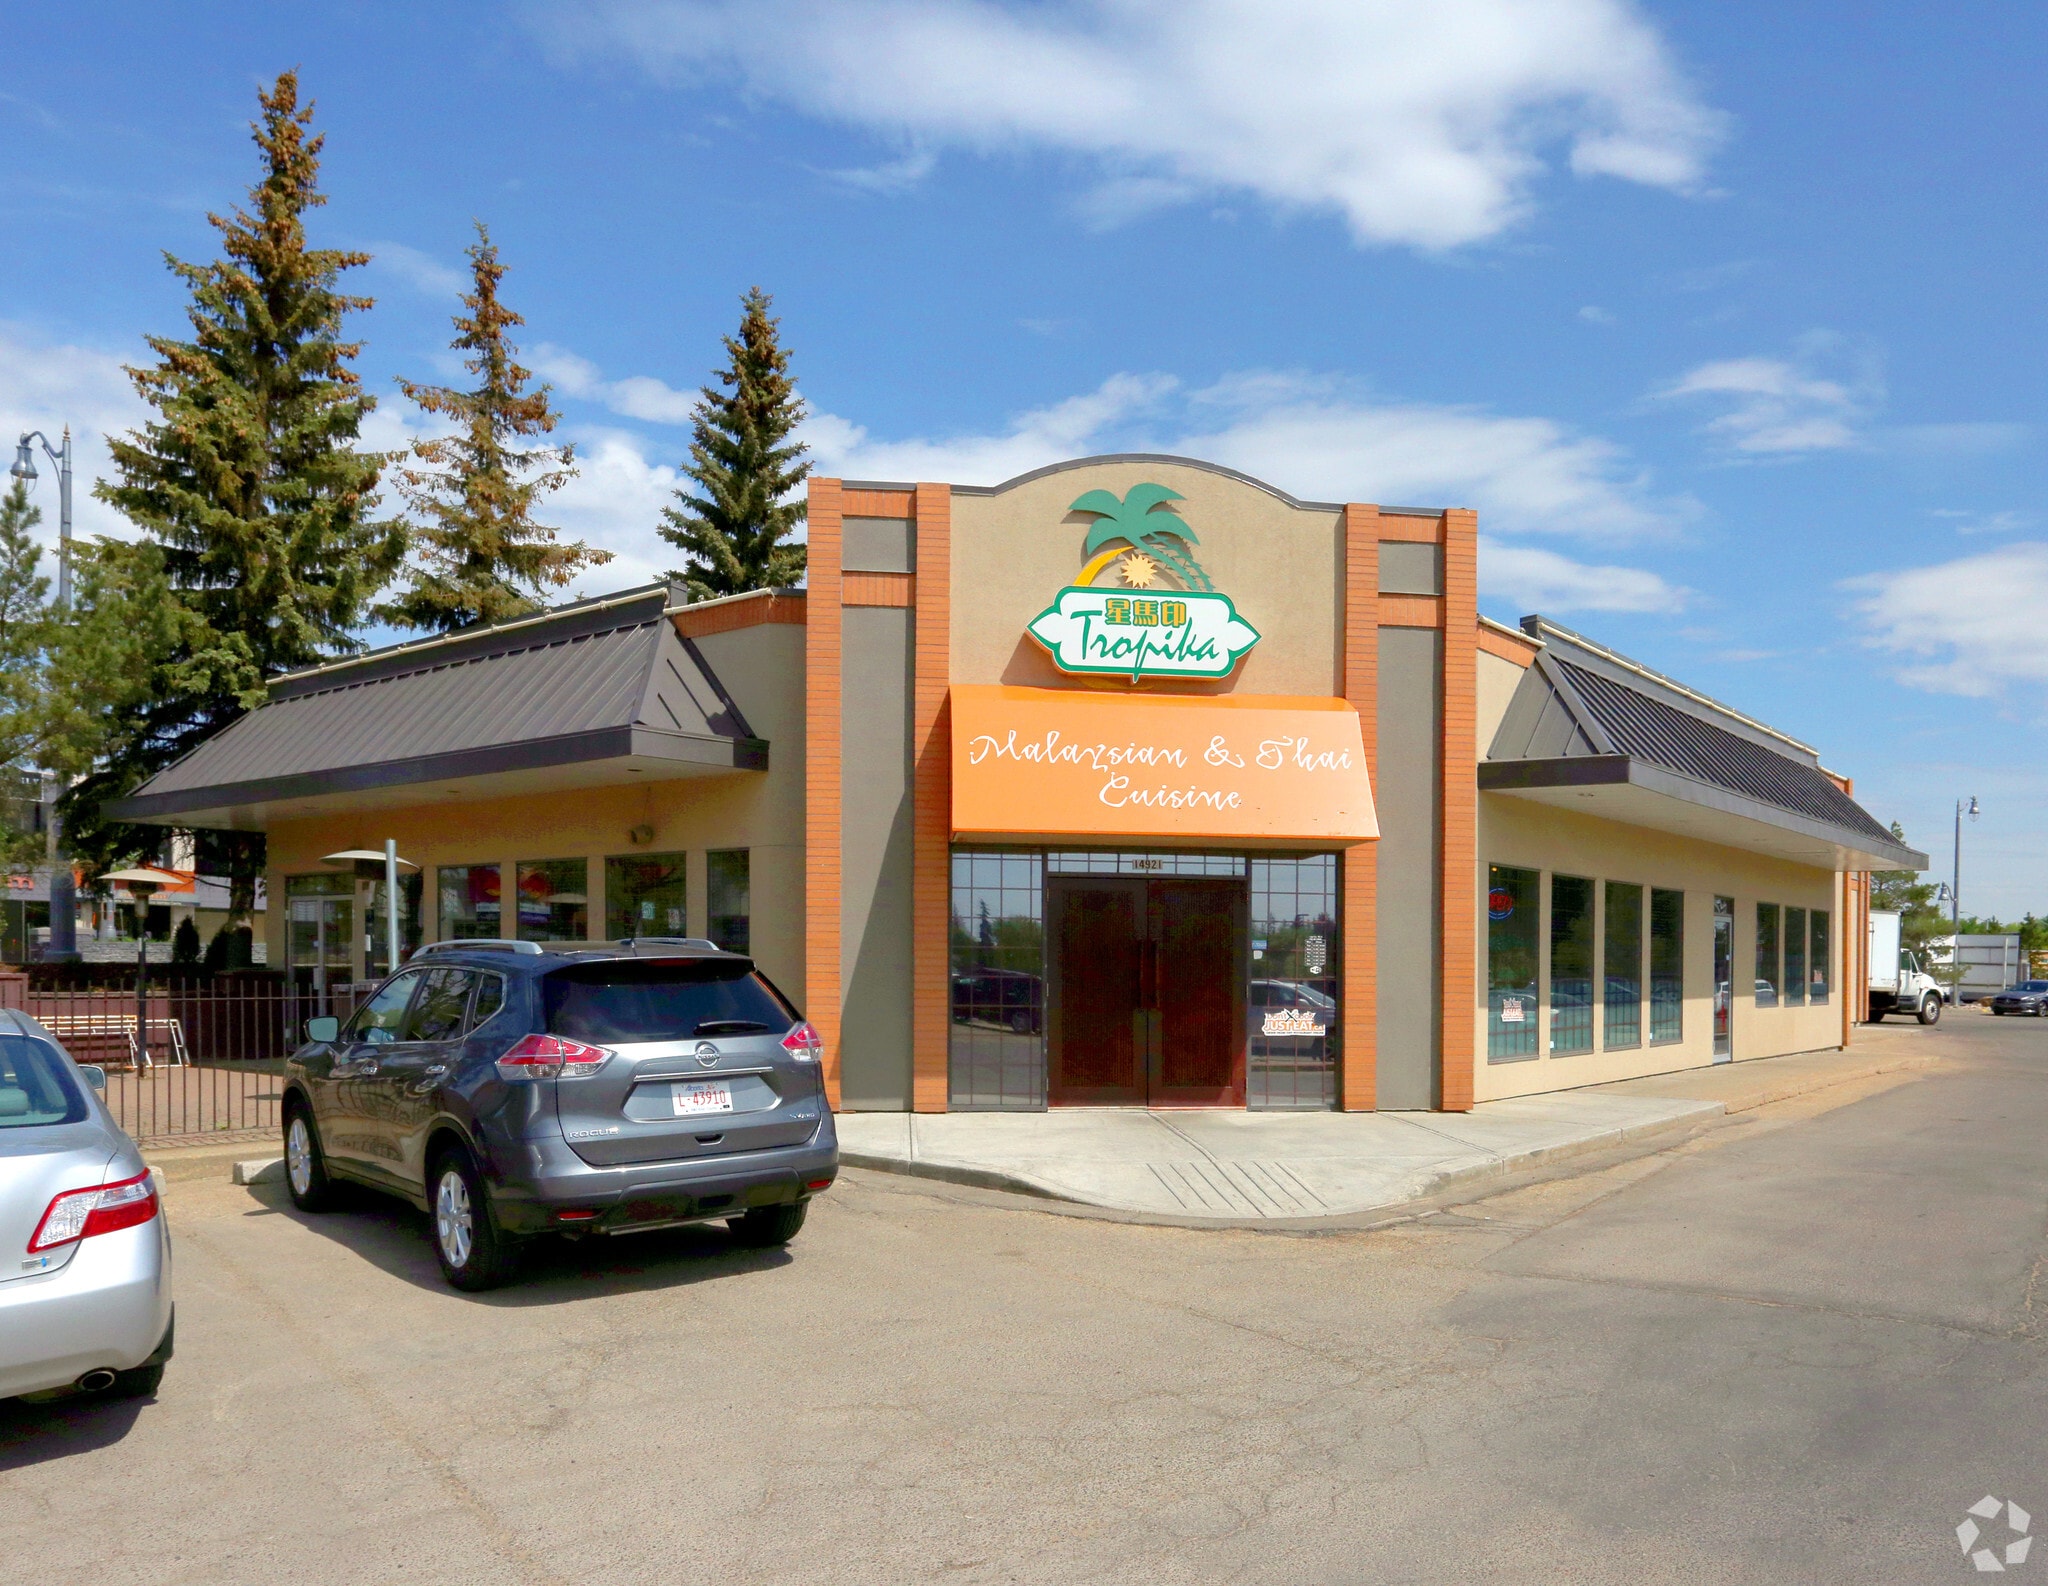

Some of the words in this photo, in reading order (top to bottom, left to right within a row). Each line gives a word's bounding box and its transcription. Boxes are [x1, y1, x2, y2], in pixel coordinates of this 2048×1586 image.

[1105, 598, 1187, 628] 星馬印
[1070, 610, 1220, 683] Tropika
[969, 730, 1188, 773] Malaysian
[1203, 736, 1246, 768] &
[1256, 736, 1353, 771] Thai
[1099, 771, 1243, 810] Cuisine
[1134, 859, 1162, 870] 14921
[568, 1126, 620, 1139] ROGUE
